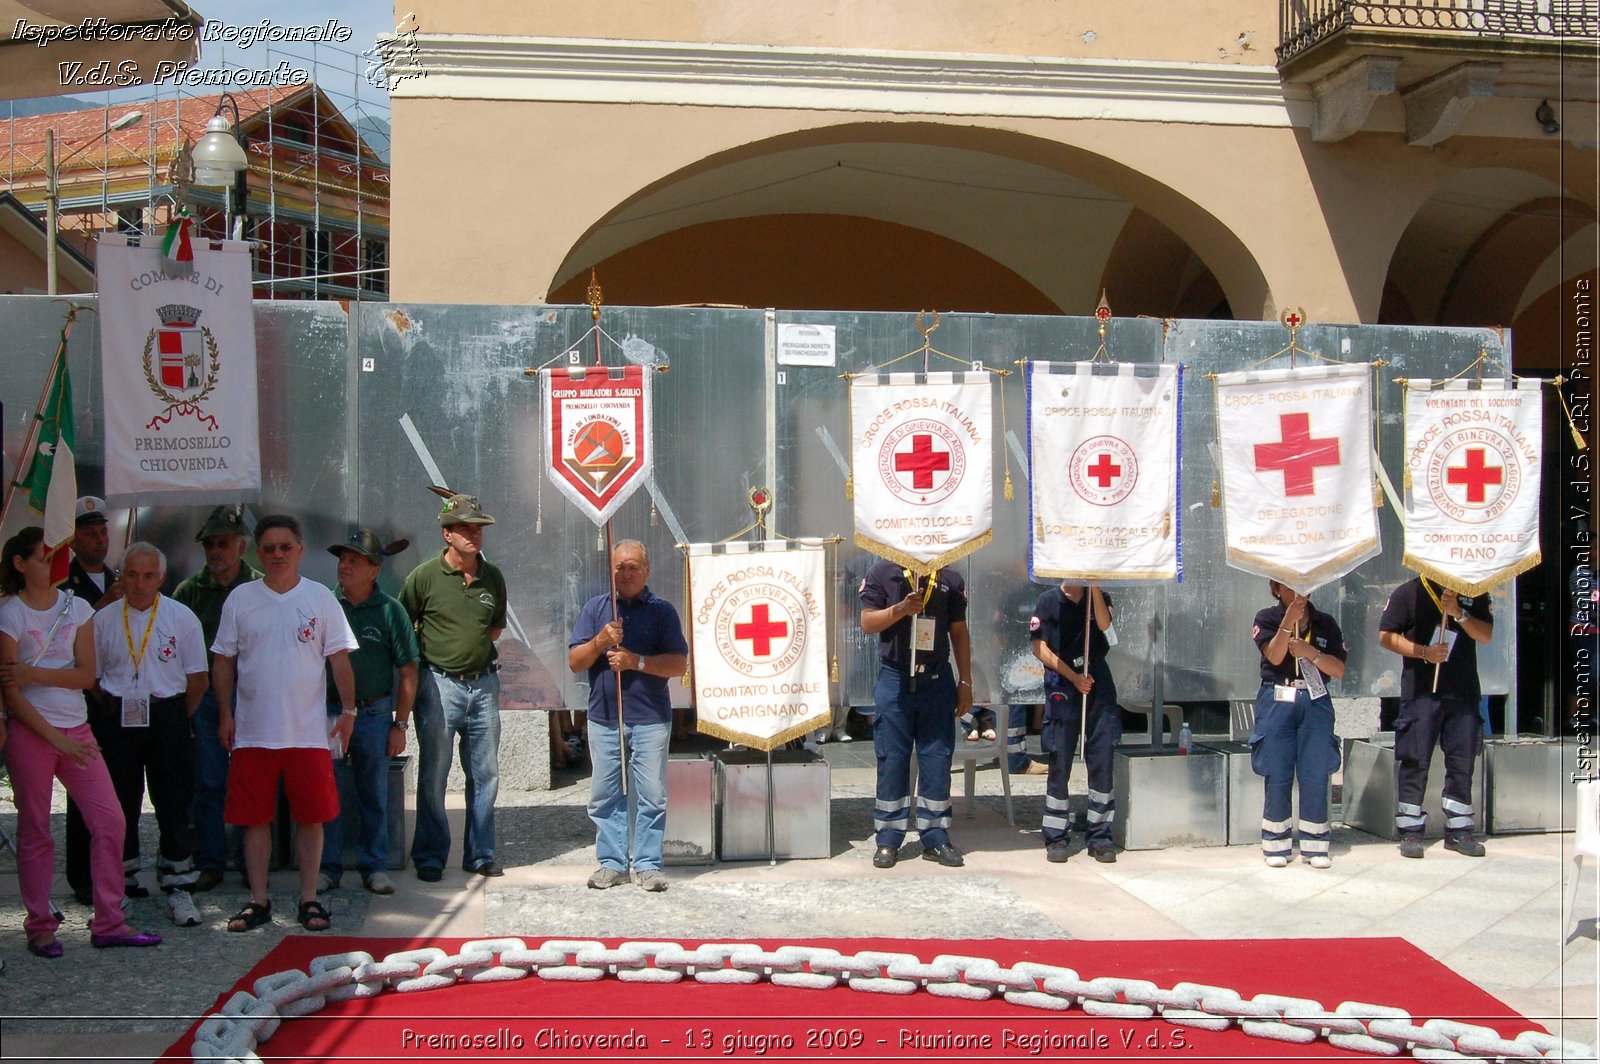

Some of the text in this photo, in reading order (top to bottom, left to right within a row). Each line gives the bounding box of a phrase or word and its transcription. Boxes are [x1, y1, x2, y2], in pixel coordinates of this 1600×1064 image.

[204, 277, 224, 296] DI
[571, 352, 578, 362] 5
[364, 361, 372, 370] 4
[975, 362, 981, 371] 2
[779, 373, 784, 383] 1
[552, 387, 641, 398] GRUPPO MURATORI S.GIULIO
[1224, 386, 1363, 408] CROCE ROSSA ITALIANA
[1425, 398, 1522, 409] VOLONTARI DEL SOCCORSO
[1044, 406, 1163, 417] CROCE ROSSA ITALIANA
[861, 398, 984, 449] CROCE ROSSA ITALIANA
[134, 435, 231, 452] PREMOSELLO
[1409, 410, 1539, 468] CROCE ROSSA ITALIANA
[1443, 438, 1455, 450] DI
[880, 421, 964, 494] CONVENZIONE DI GINEVRA 22 AGOSTO 1864
[1502, 447, 1514, 459] 22
[139, 456, 229, 472] CHIOVENDA
[1430, 452, 1465, 518] CONVENZIONE
[1503, 462, 1518, 501] AGOSTO
[1258, 504, 1343, 521] DELEGAZIONE
[875, 515, 974, 530] COMITATO LOCALE
[1296, 520, 1308, 531] DI
[901, 534, 949, 546] VIGONE
[1078, 537, 1128, 549] GALLIATE
[1239, 531, 1326, 546] GRAVELLONA
[1424, 532, 1525, 544] COMITATO LOCALE
[1449, 547, 1497, 560] FIANO
[698, 566, 822, 625] CROCE ROSSA ITALIANA
[729, 595, 741, 607] DI
[788, 603, 801, 616] 22
[718, 609, 753, 673] CONVENZIONE
[702, 683, 821, 699] COMITATO LOCALE
[717, 702, 809, 721] CARIGNANO
